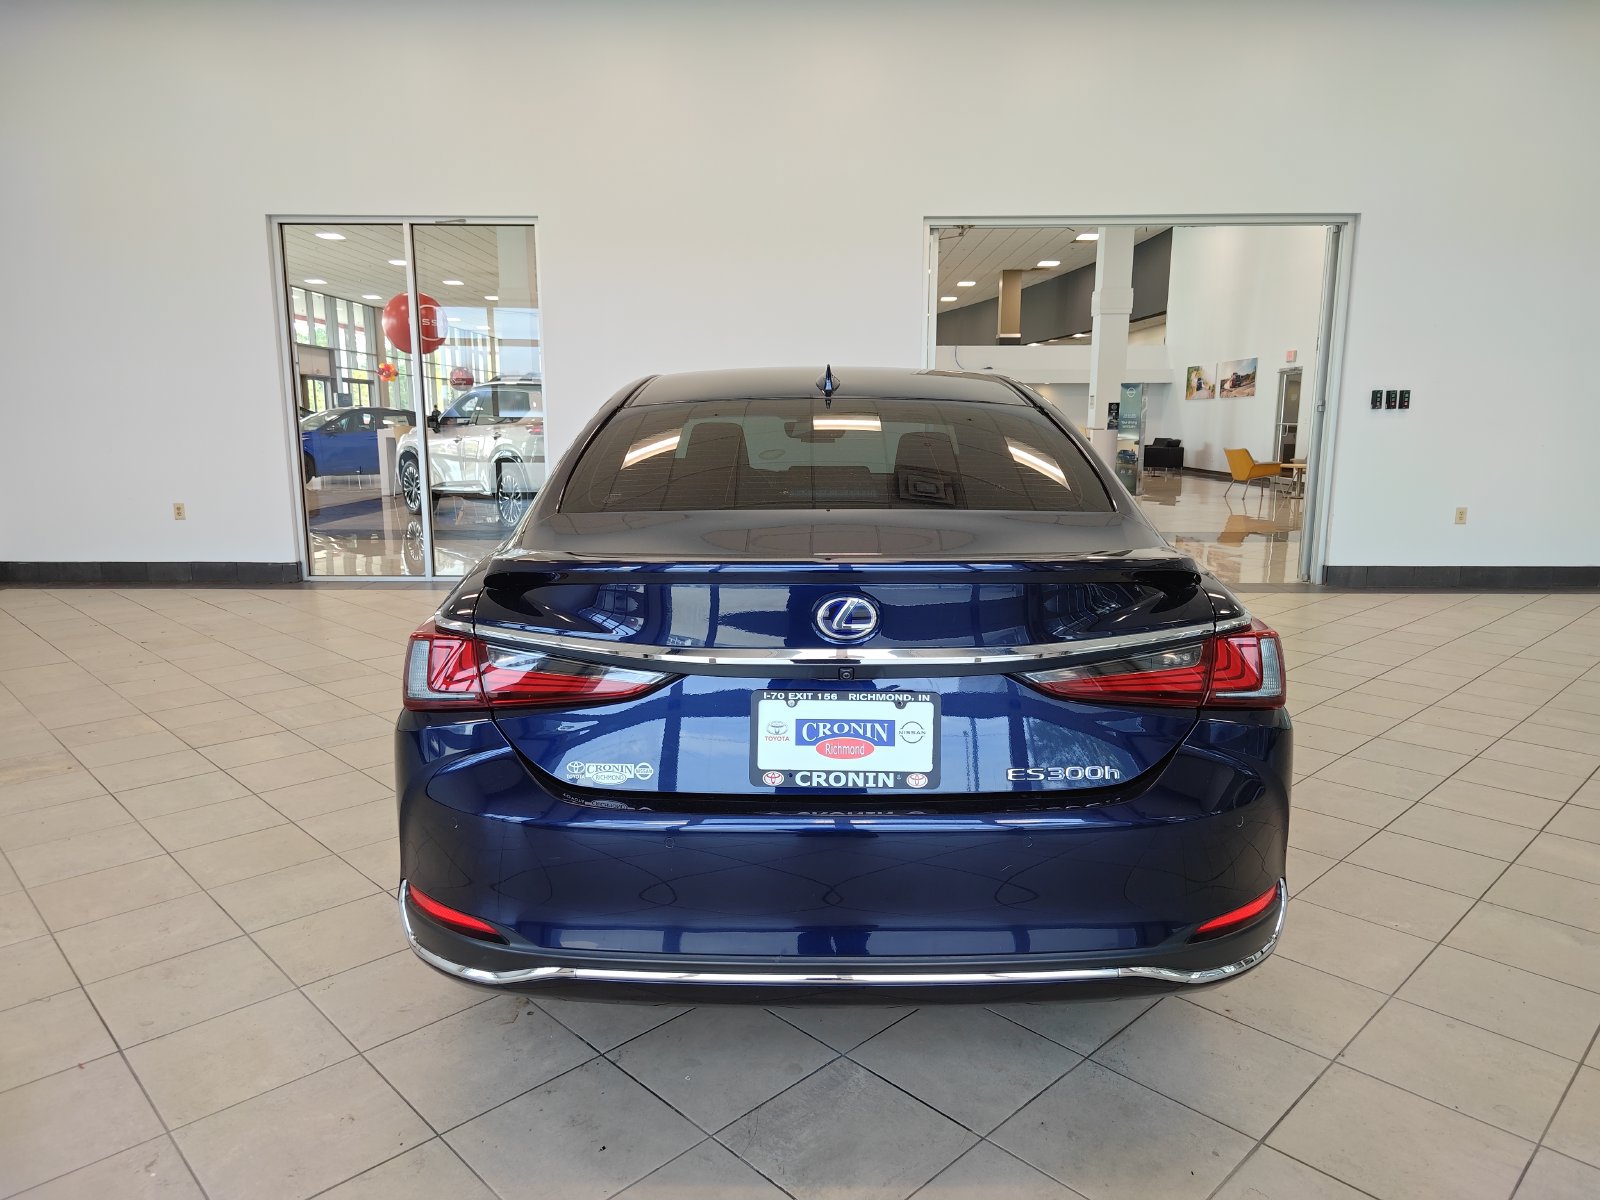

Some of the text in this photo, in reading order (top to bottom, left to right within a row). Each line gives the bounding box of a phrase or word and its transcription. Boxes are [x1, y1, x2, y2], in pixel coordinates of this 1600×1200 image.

[763, 692, 838, 701] I-70 EXIT 156
[918, 694, 931, 702] IN
[801, 722, 889, 743] CRONIN
[825, 743, 865, 755] Richmond
[586, 764, 633, 774] CRONIN
[1007, 765, 1120, 781] ES300h
[794, 771, 895, 788] CRONIN
